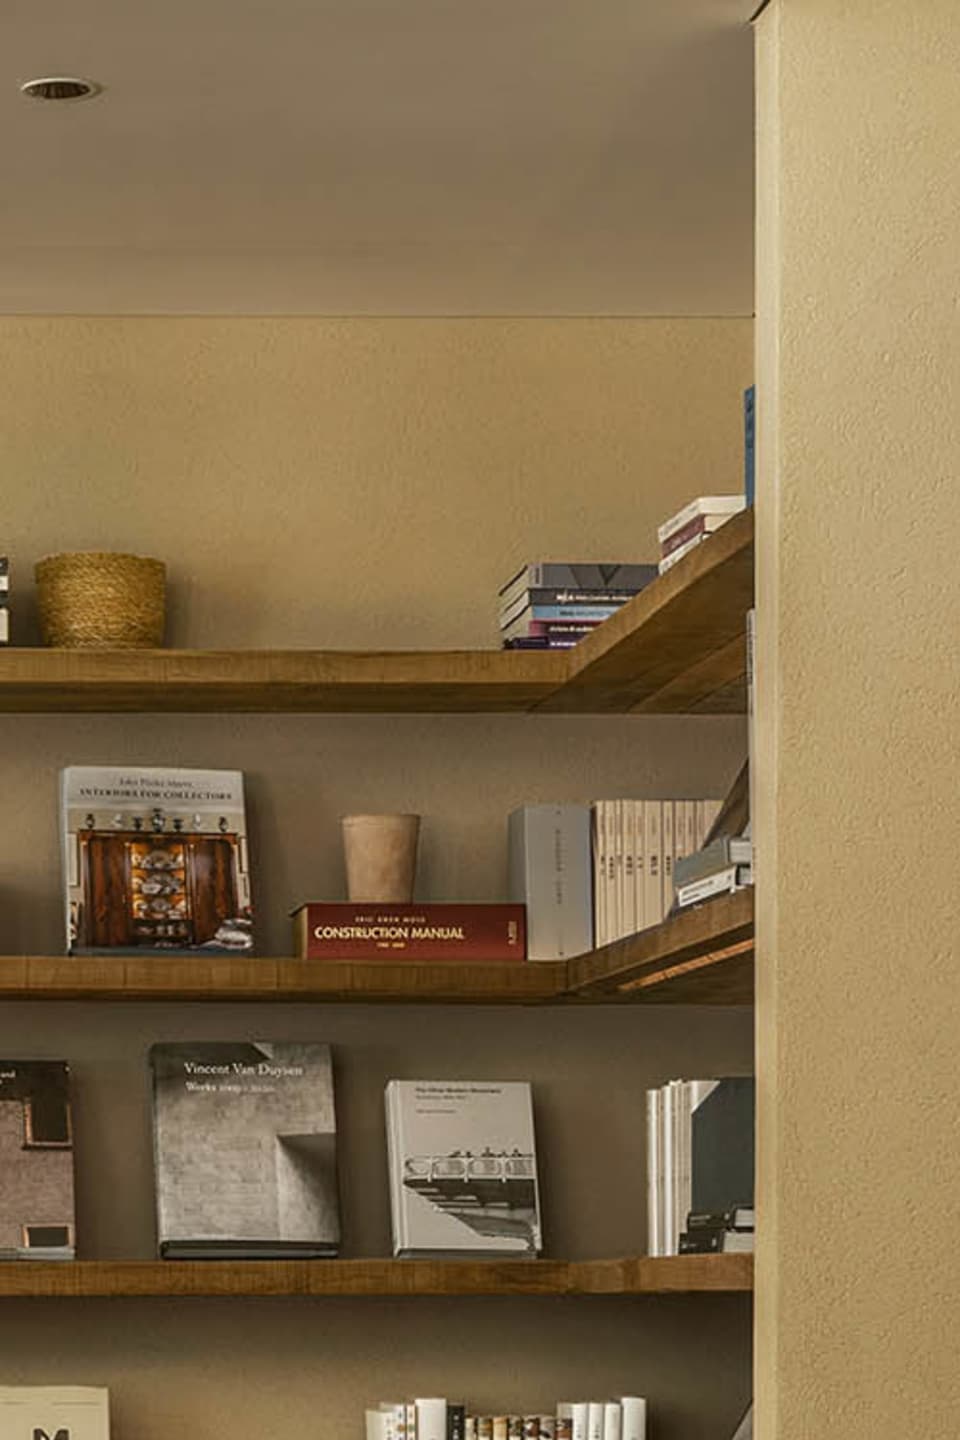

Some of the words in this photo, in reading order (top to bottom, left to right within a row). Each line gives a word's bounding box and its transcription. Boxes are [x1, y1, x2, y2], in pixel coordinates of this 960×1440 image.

[314, 926, 409, 940] CONSTRUCTION
[411, 926, 464, 940] MANUAL
[184, 1062, 230, 1074] Vincent
[232, 1062, 255, 1075] Van
[258, 1063, 303, 1078] Duysen
